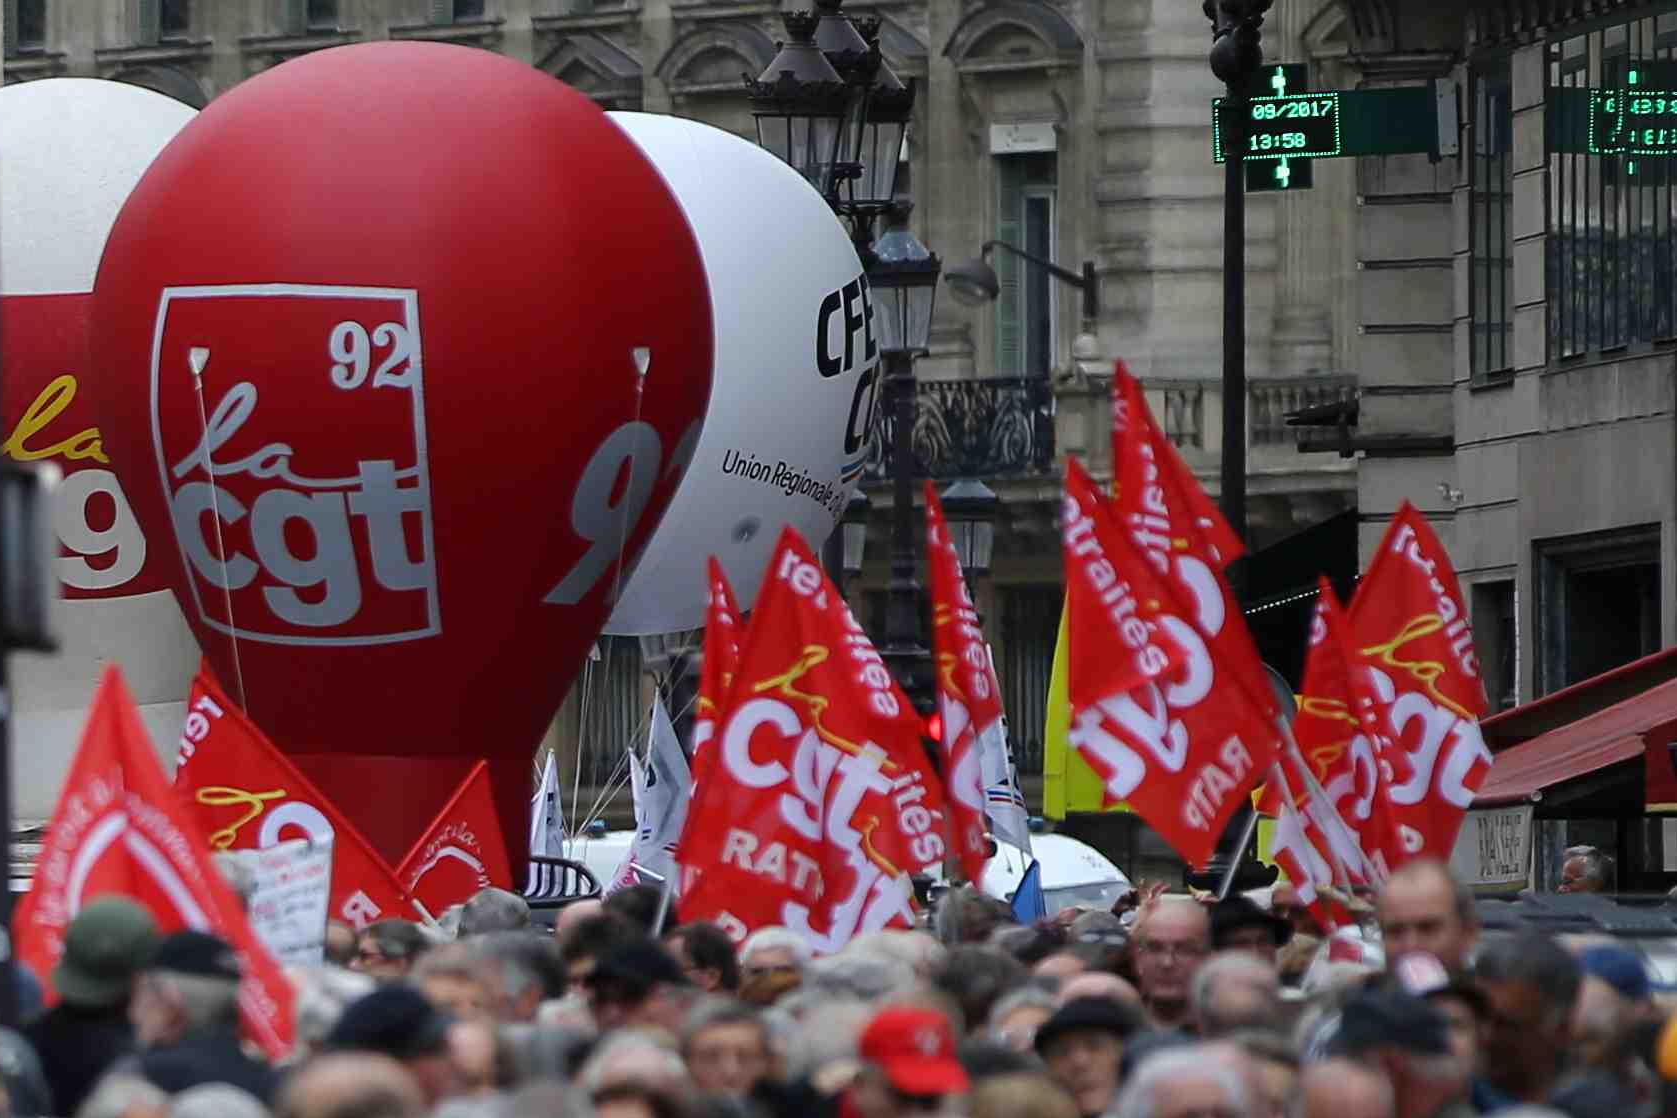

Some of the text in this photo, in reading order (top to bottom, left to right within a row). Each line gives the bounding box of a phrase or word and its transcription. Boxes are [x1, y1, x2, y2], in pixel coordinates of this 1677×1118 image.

[1250, 132, 1306, 151] 13:58
[330, 319, 415, 392] 92
[722, 449, 772, 483] Union
[171, 459, 432, 627] cgt
[1061, 490, 1170, 676] etraités
